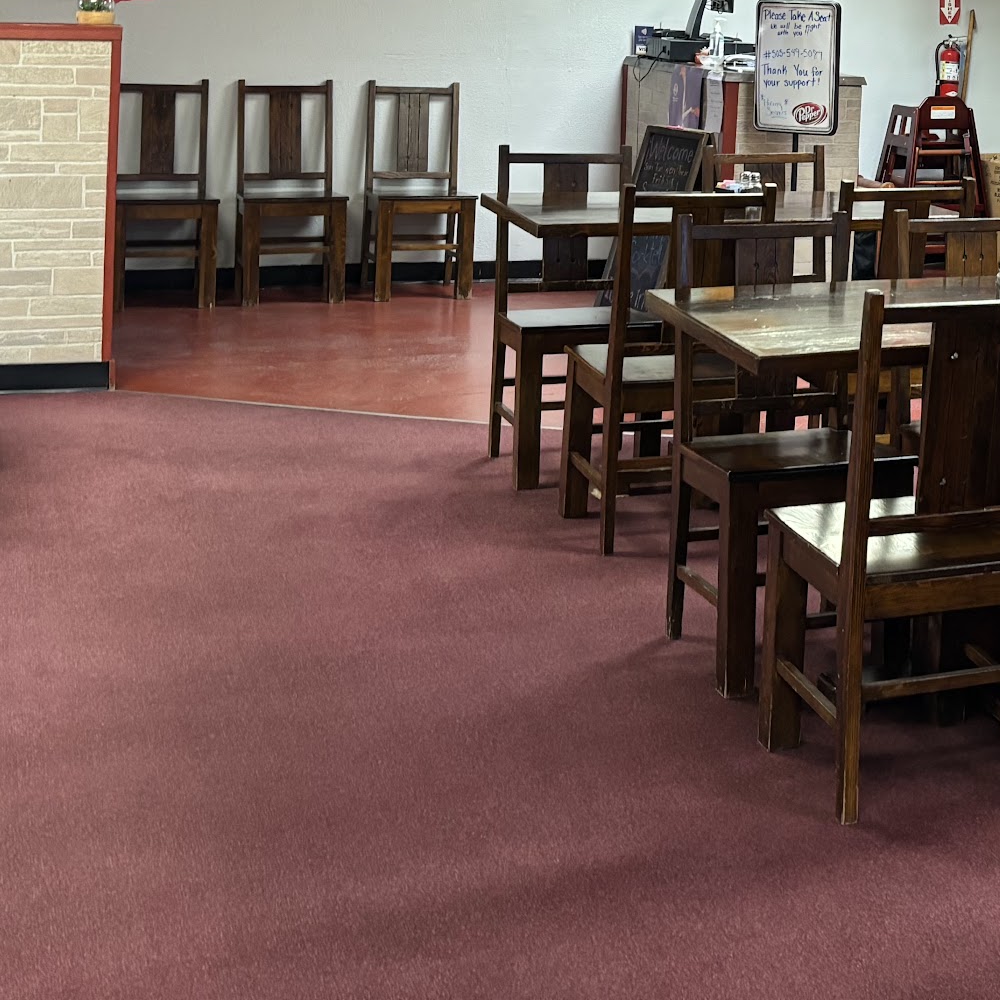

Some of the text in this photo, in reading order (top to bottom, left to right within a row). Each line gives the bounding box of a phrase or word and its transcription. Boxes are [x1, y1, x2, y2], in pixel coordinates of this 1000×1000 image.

[763, 9, 786, 20] Please
[789, 8, 806, 22] Take
[805, 23, 821, 32] right
[761, 63, 823, 76] Thank You for
[763, 77, 820, 90] your support!
[798, 107, 820, 122] Pepper
[646, 135, 693, 163] Welcome
